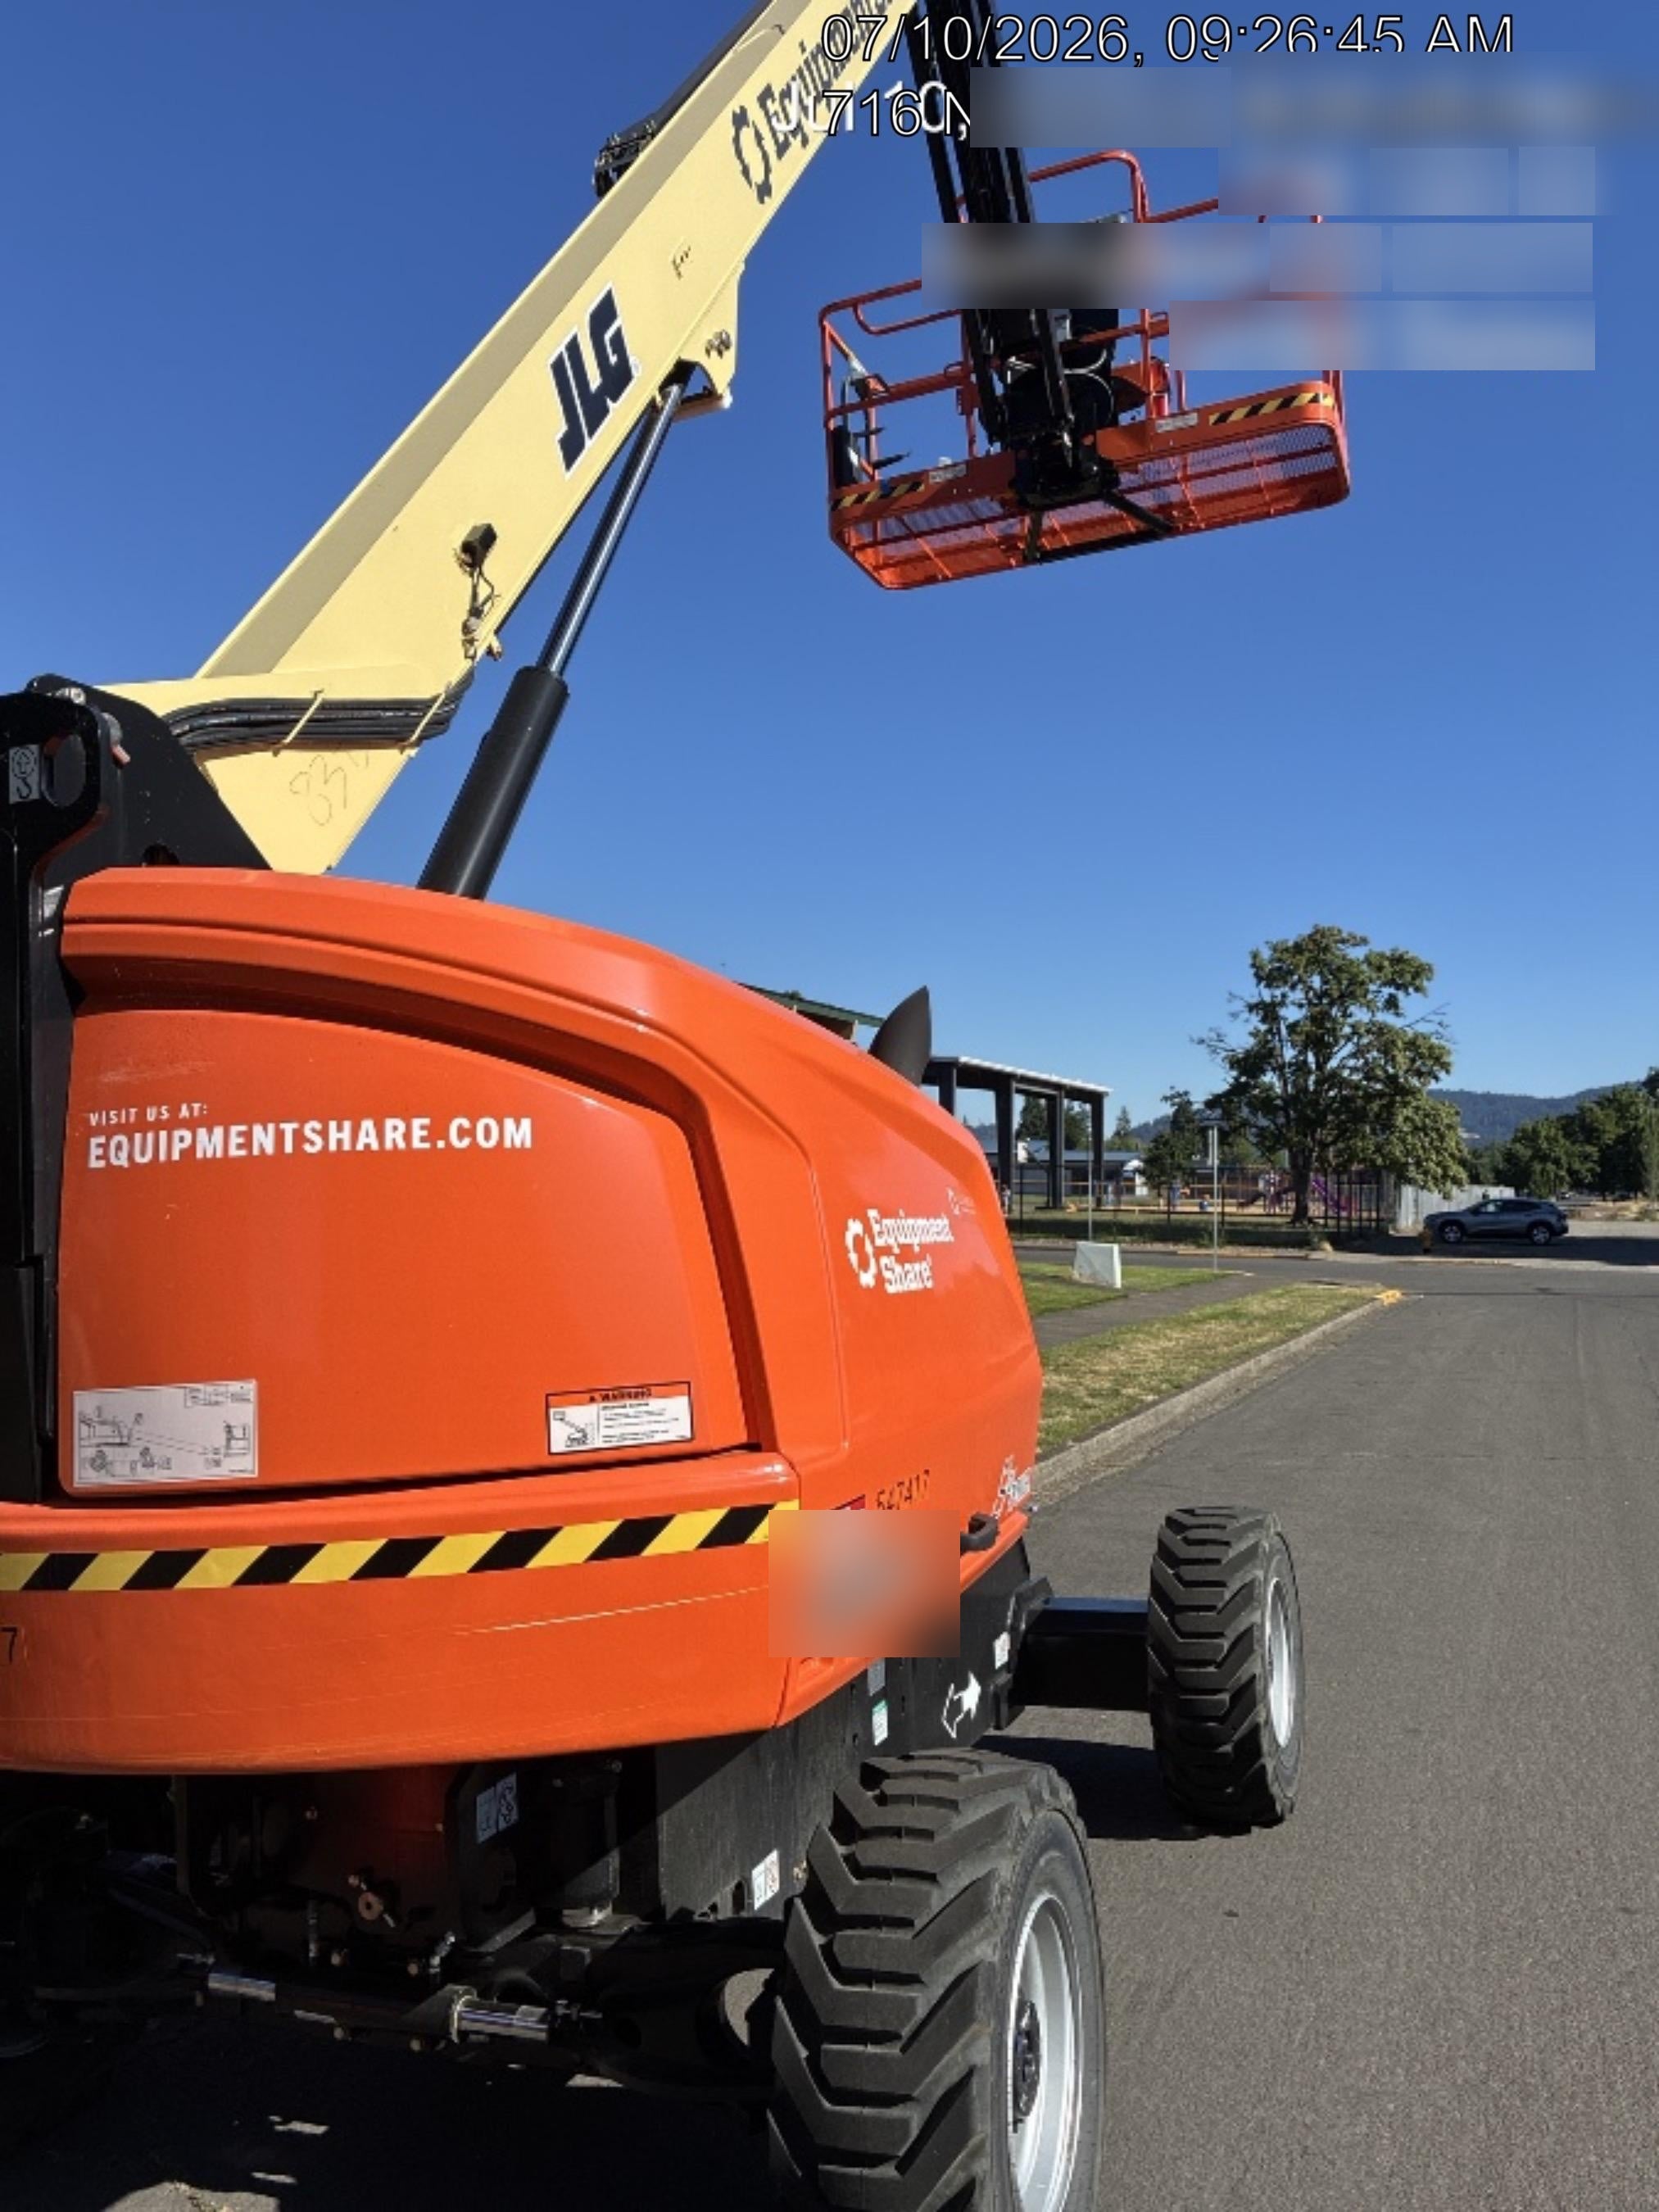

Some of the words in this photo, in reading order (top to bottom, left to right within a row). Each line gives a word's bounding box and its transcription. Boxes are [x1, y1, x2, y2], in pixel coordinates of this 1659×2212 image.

[548, 283, 636, 475] JLG
[89, 1108, 138, 1127] VISIT
[147, 1105, 170, 1122] US
[179, 1103, 207, 1119] AT:
[88, 1117, 533, 1169] EQUIPMENTSHARE.COM
